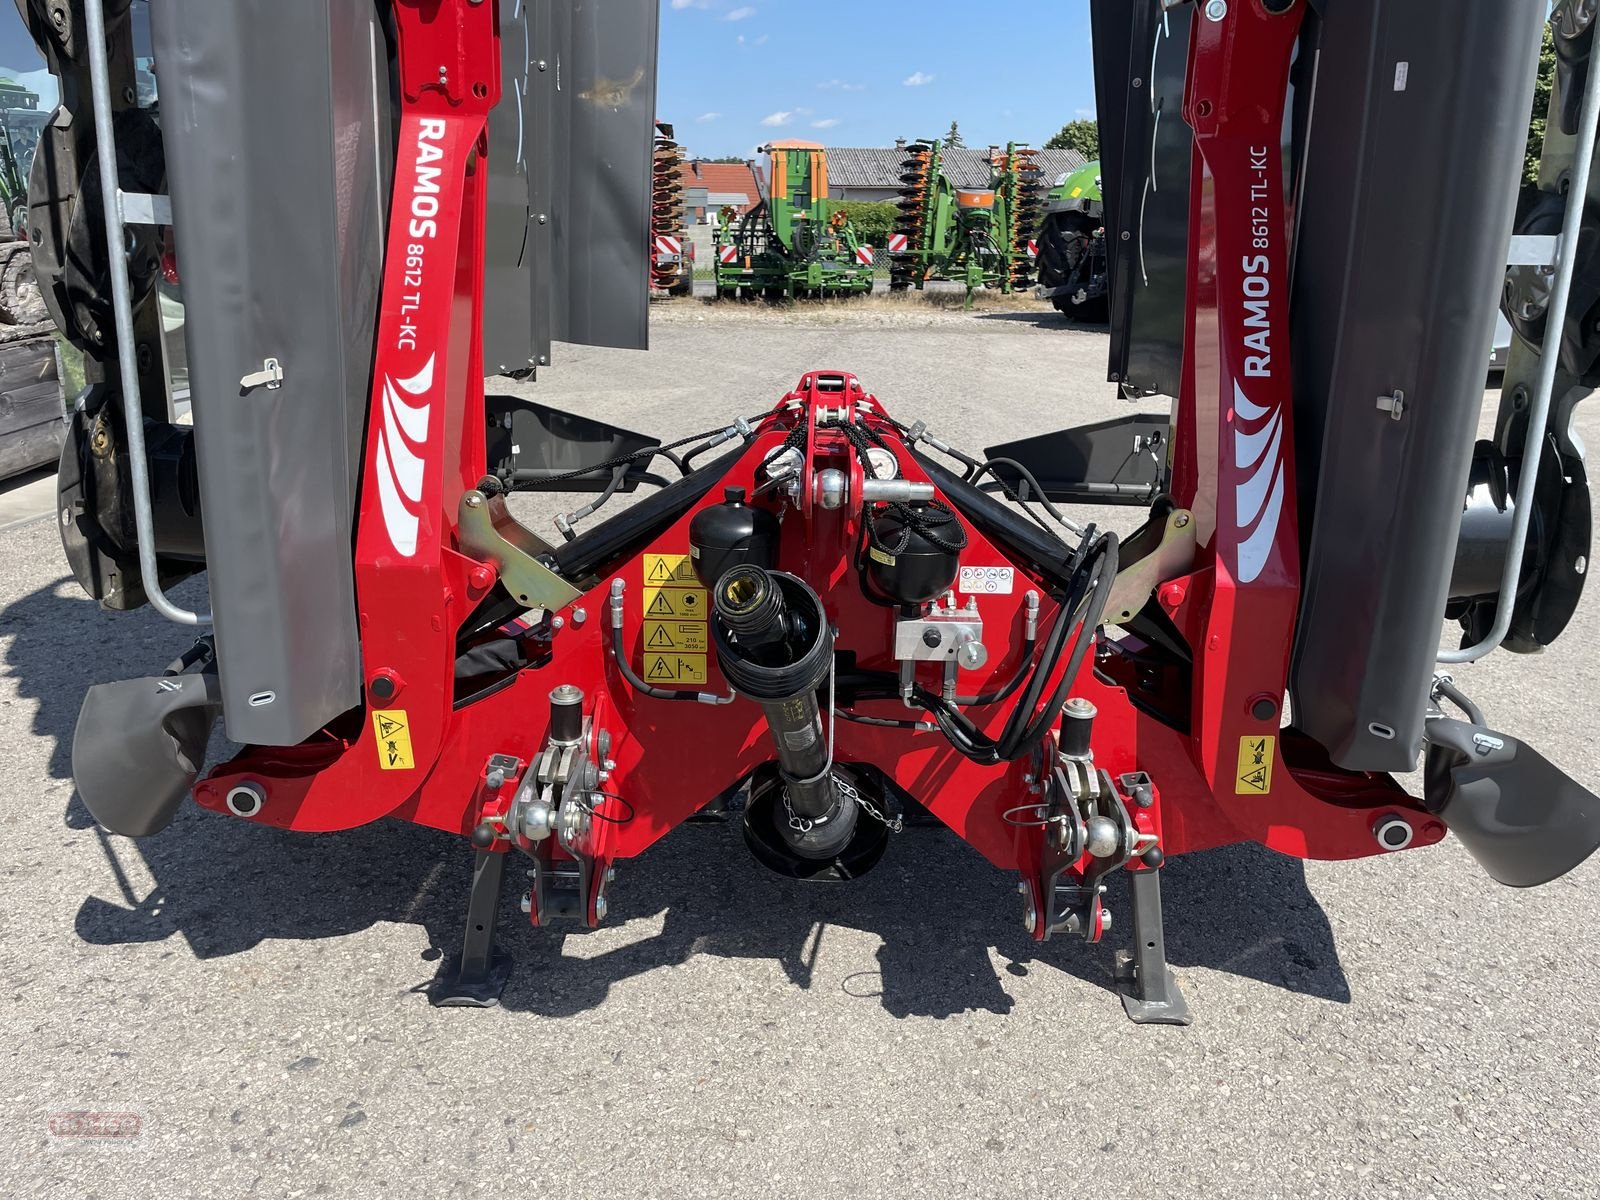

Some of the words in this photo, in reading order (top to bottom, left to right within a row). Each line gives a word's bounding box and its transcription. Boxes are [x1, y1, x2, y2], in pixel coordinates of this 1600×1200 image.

[409, 117, 446, 239] RAMOS
[1250, 146, 1267, 202] TL-KC
[1251, 207, 1269, 249] 8612
[404, 243, 425, 287] 8612
[397, 291, 421, 351] TL-KC
[1243, 255, 1271, 378] RAMOS
